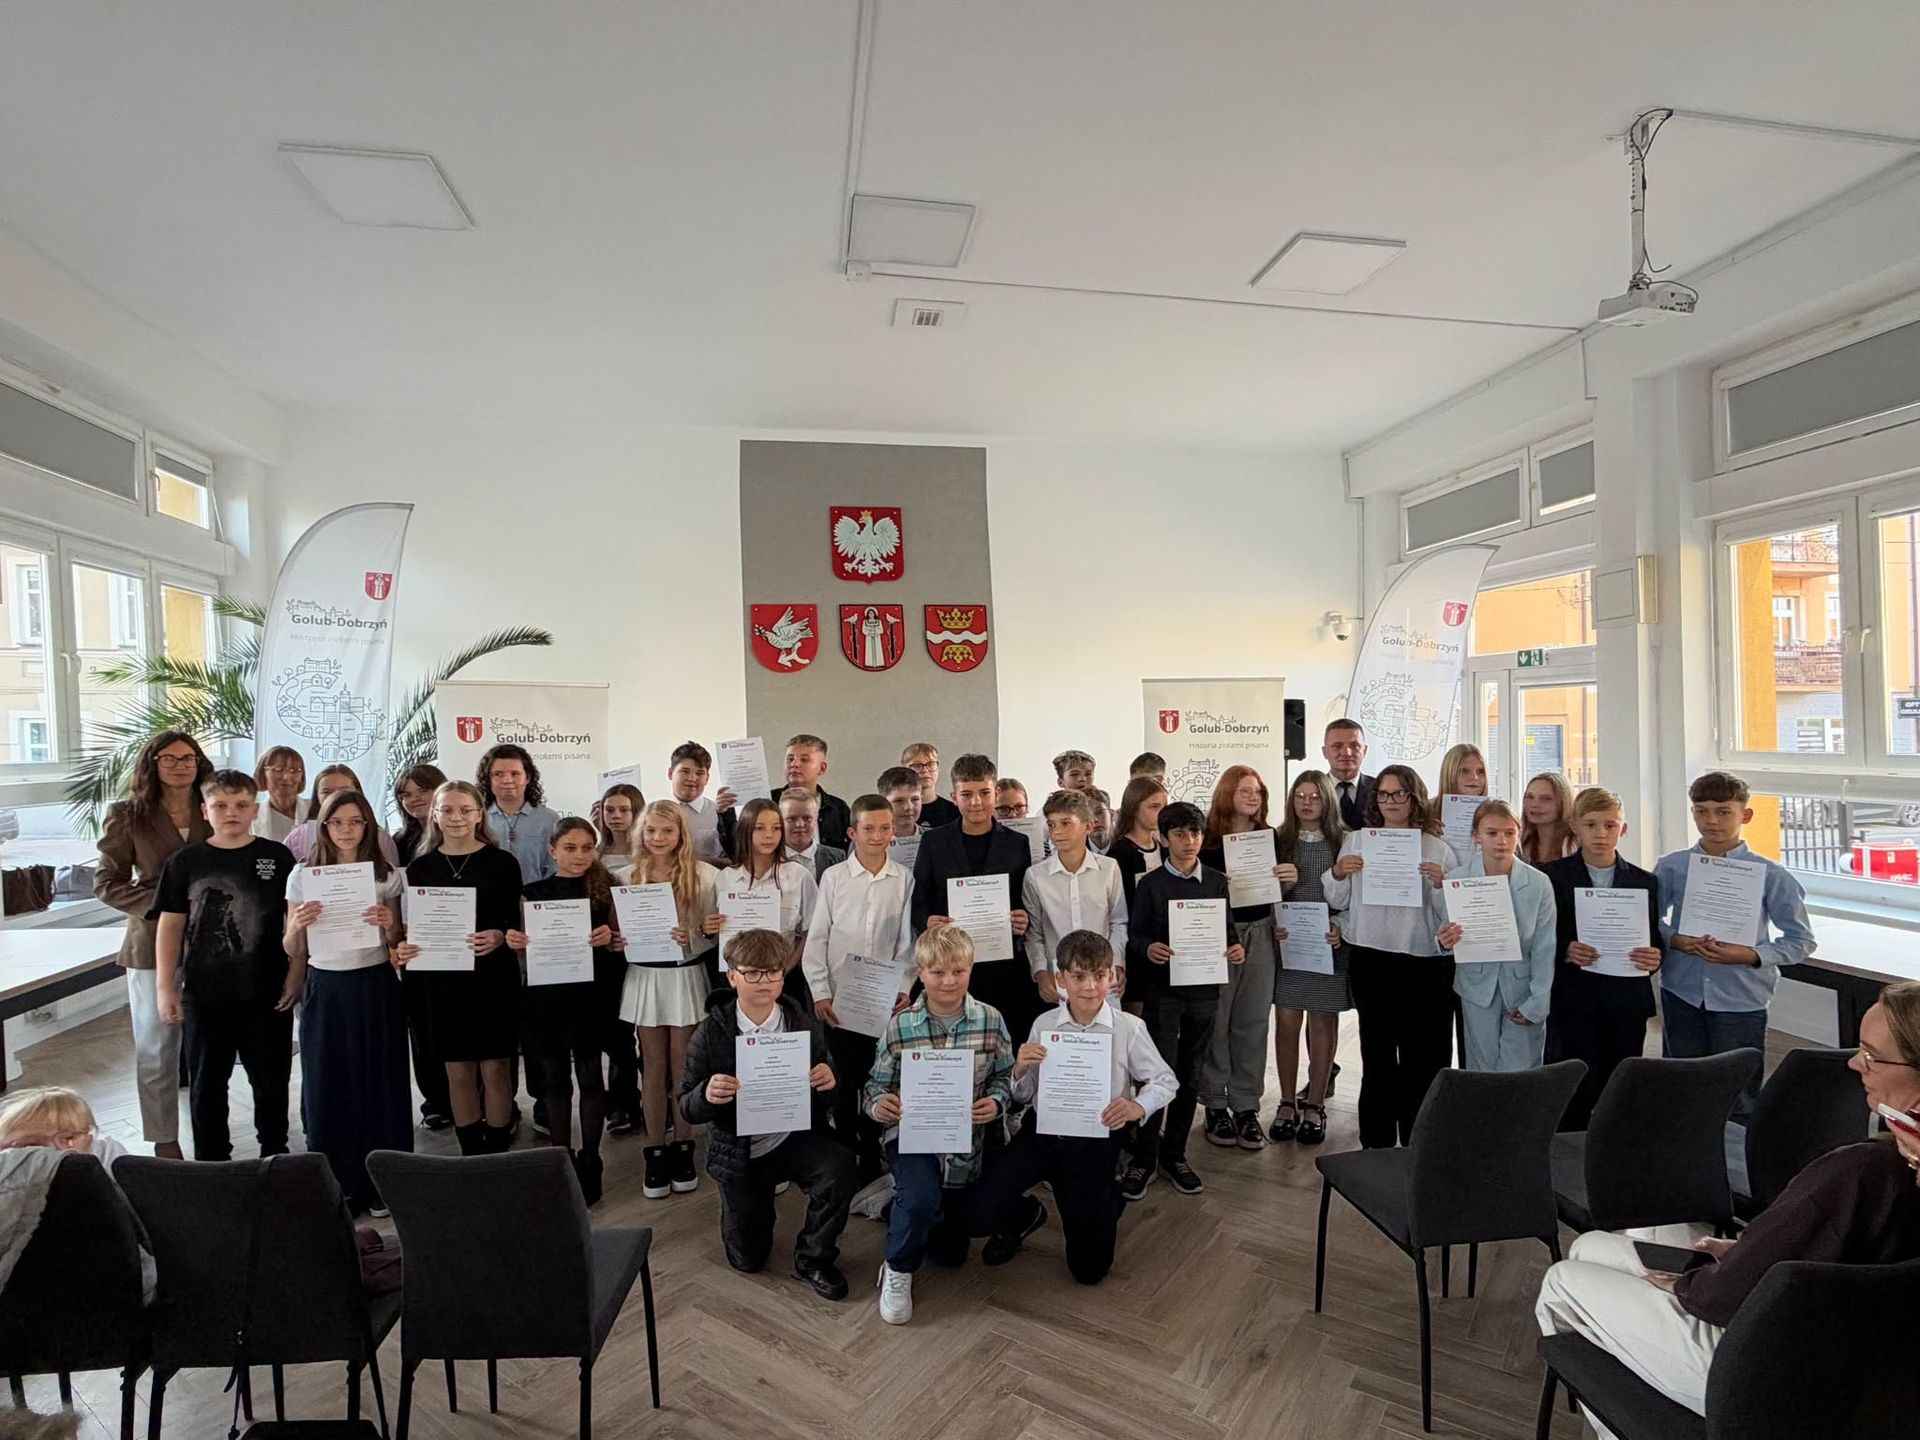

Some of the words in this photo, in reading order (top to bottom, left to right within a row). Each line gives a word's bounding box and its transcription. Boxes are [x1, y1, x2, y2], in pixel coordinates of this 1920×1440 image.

[292, 614, 388, 631] Golub-Dobrzyń
[1189, 724, 1270, 735] Golub-Dobrzyń
[496, 733, 591, 745] Golub-Dobrzyń
[1189, 741, 1217, 749] Historia
[564, 752, 591, 761] pisana
